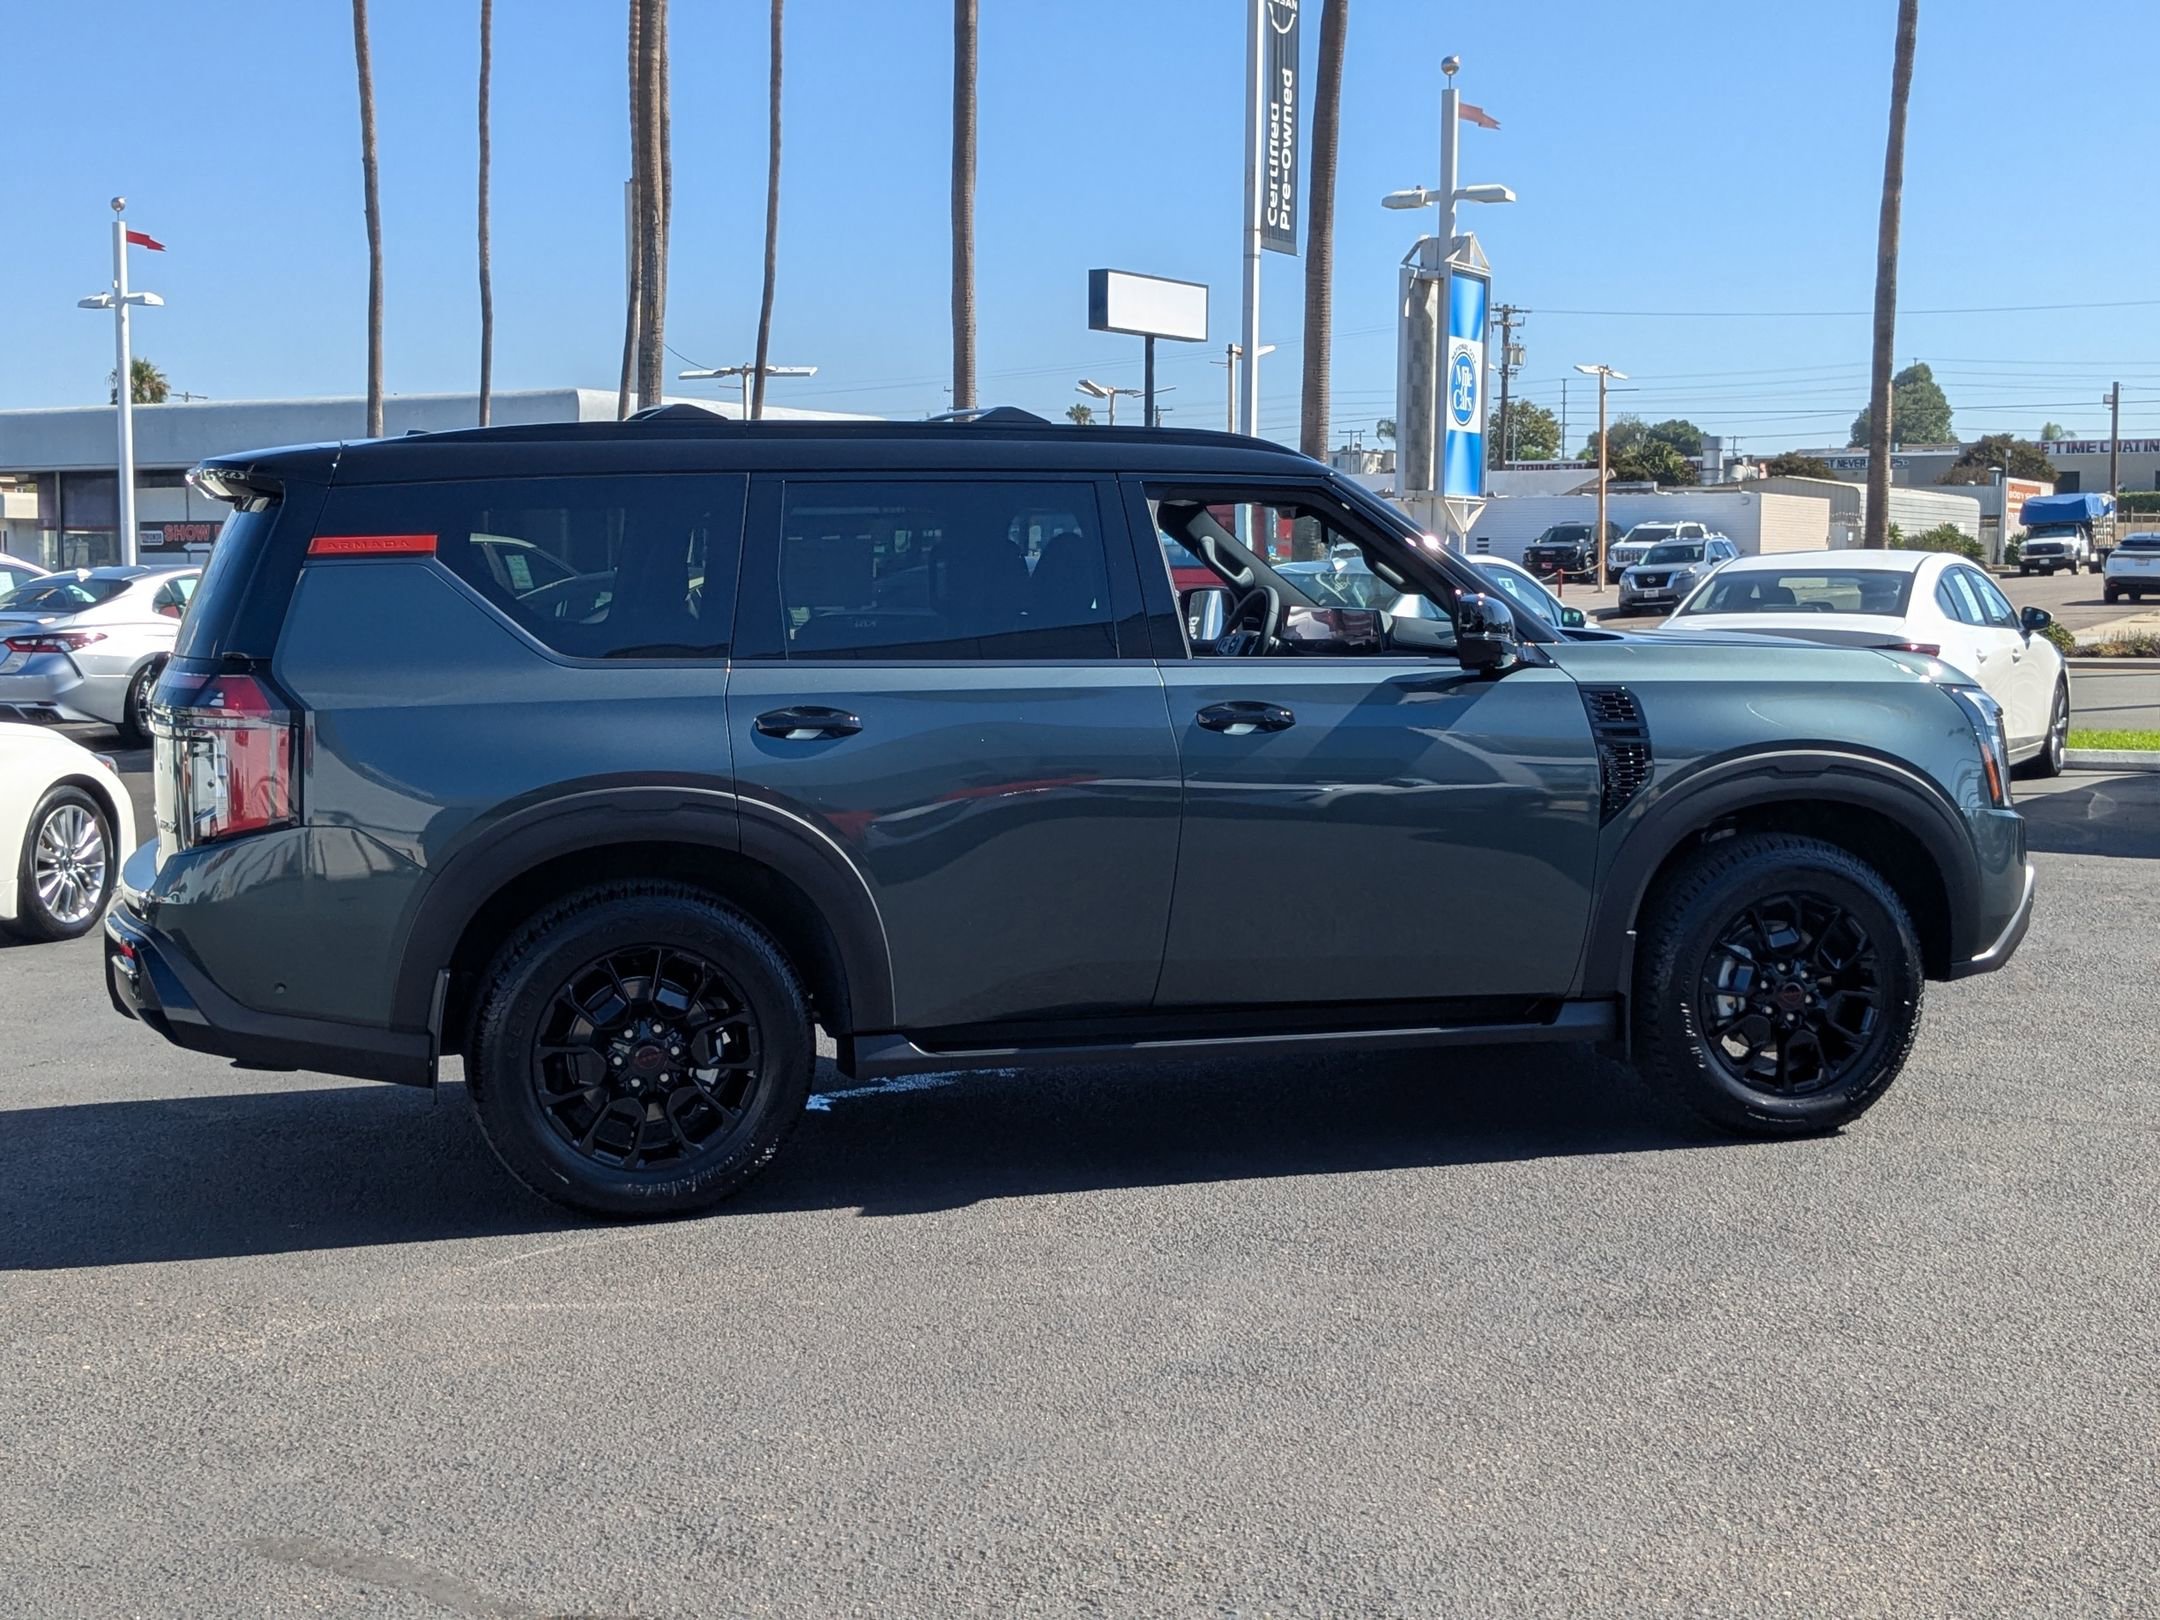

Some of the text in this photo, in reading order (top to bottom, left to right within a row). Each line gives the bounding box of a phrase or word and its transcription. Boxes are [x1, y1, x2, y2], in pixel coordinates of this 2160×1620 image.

[1279, 67, 1293, 231] Pre-Owned
[1267, 101, 1280, 227] Certified
[2052, 441, 2097, 454] TIME
[164, 524, 210, 542] SHOW
[327, 540, 410, 550] ARMADA
